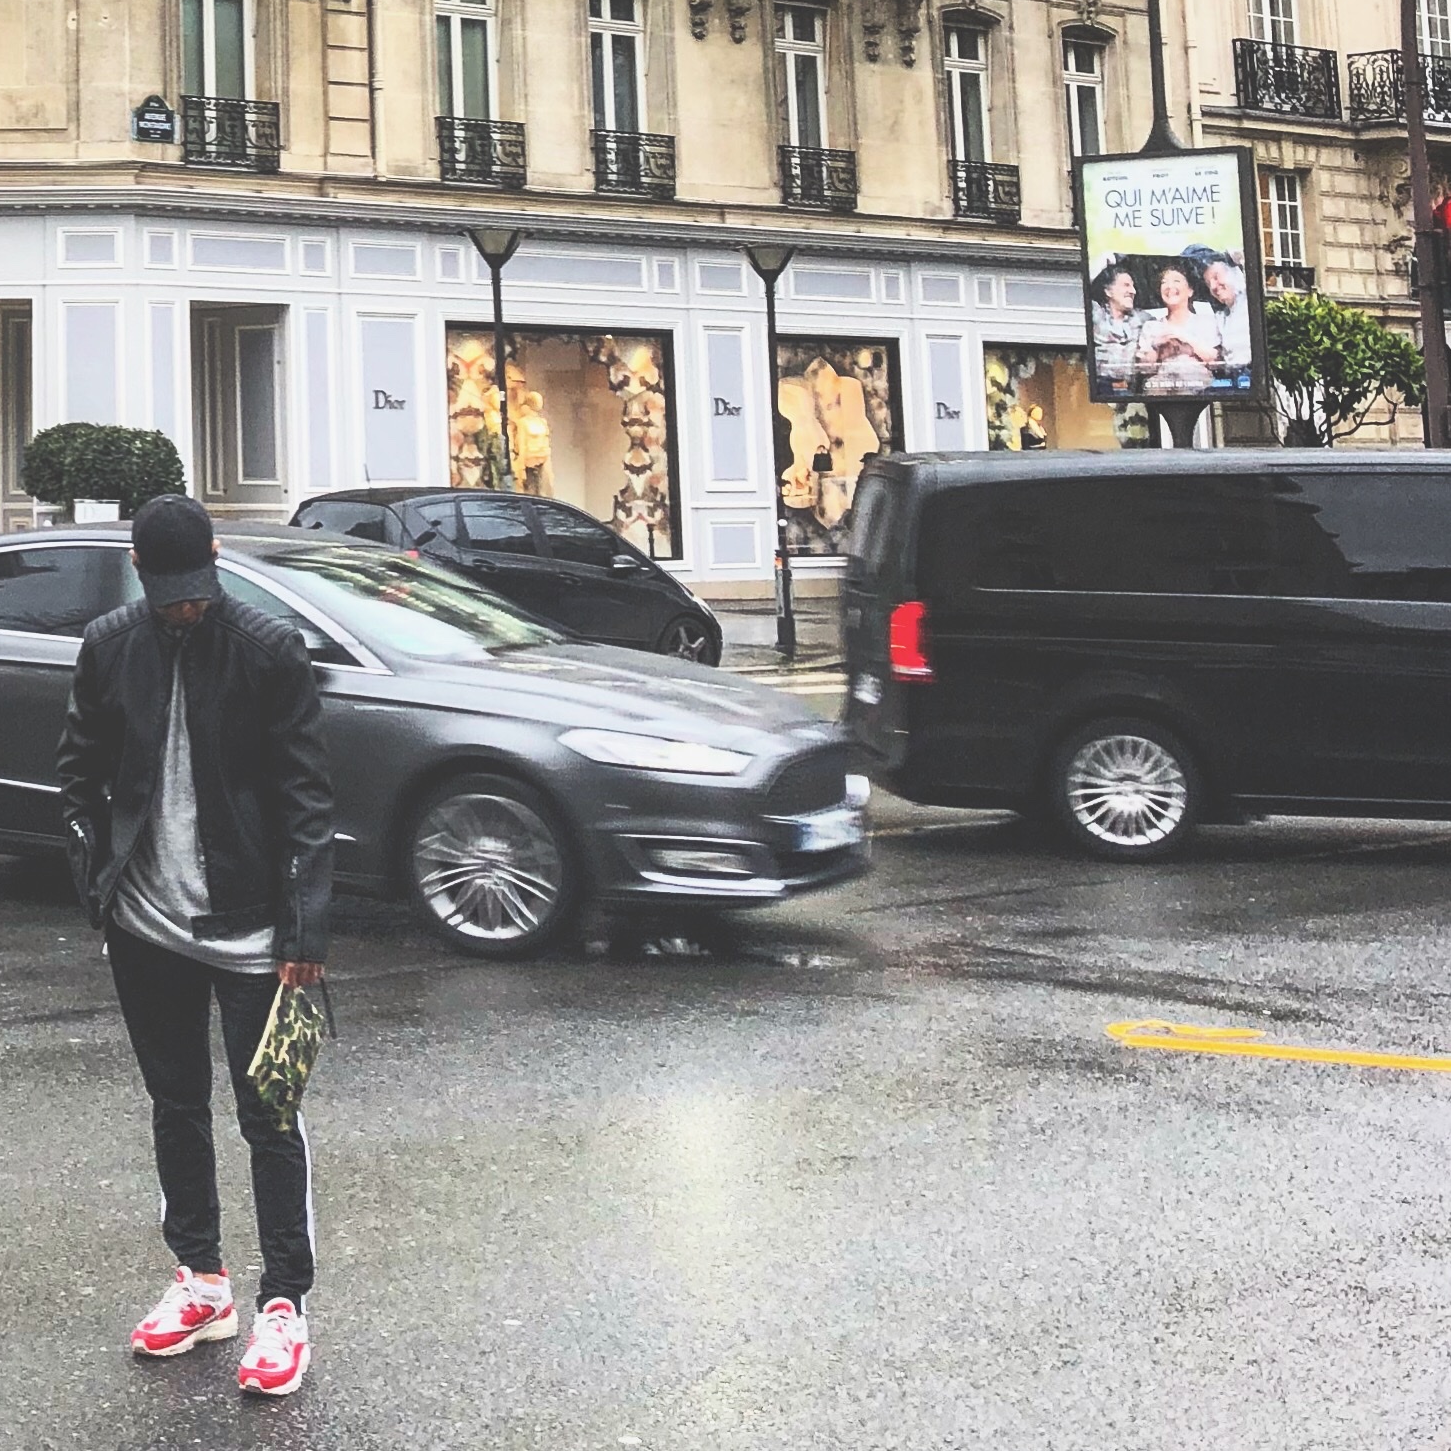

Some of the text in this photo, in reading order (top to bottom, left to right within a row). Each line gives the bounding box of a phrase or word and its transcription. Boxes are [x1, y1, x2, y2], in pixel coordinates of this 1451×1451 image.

[1105, 184, 1220, 208] QUI M'AIME
[1114, 209, 1142, 228] ME
[1150, 206, 1205, 227] SUIVE
[372, 389, 406, 410] Dior
[713, 397, 742, 416] Dior
[935, 402, 960, 419] Dior
